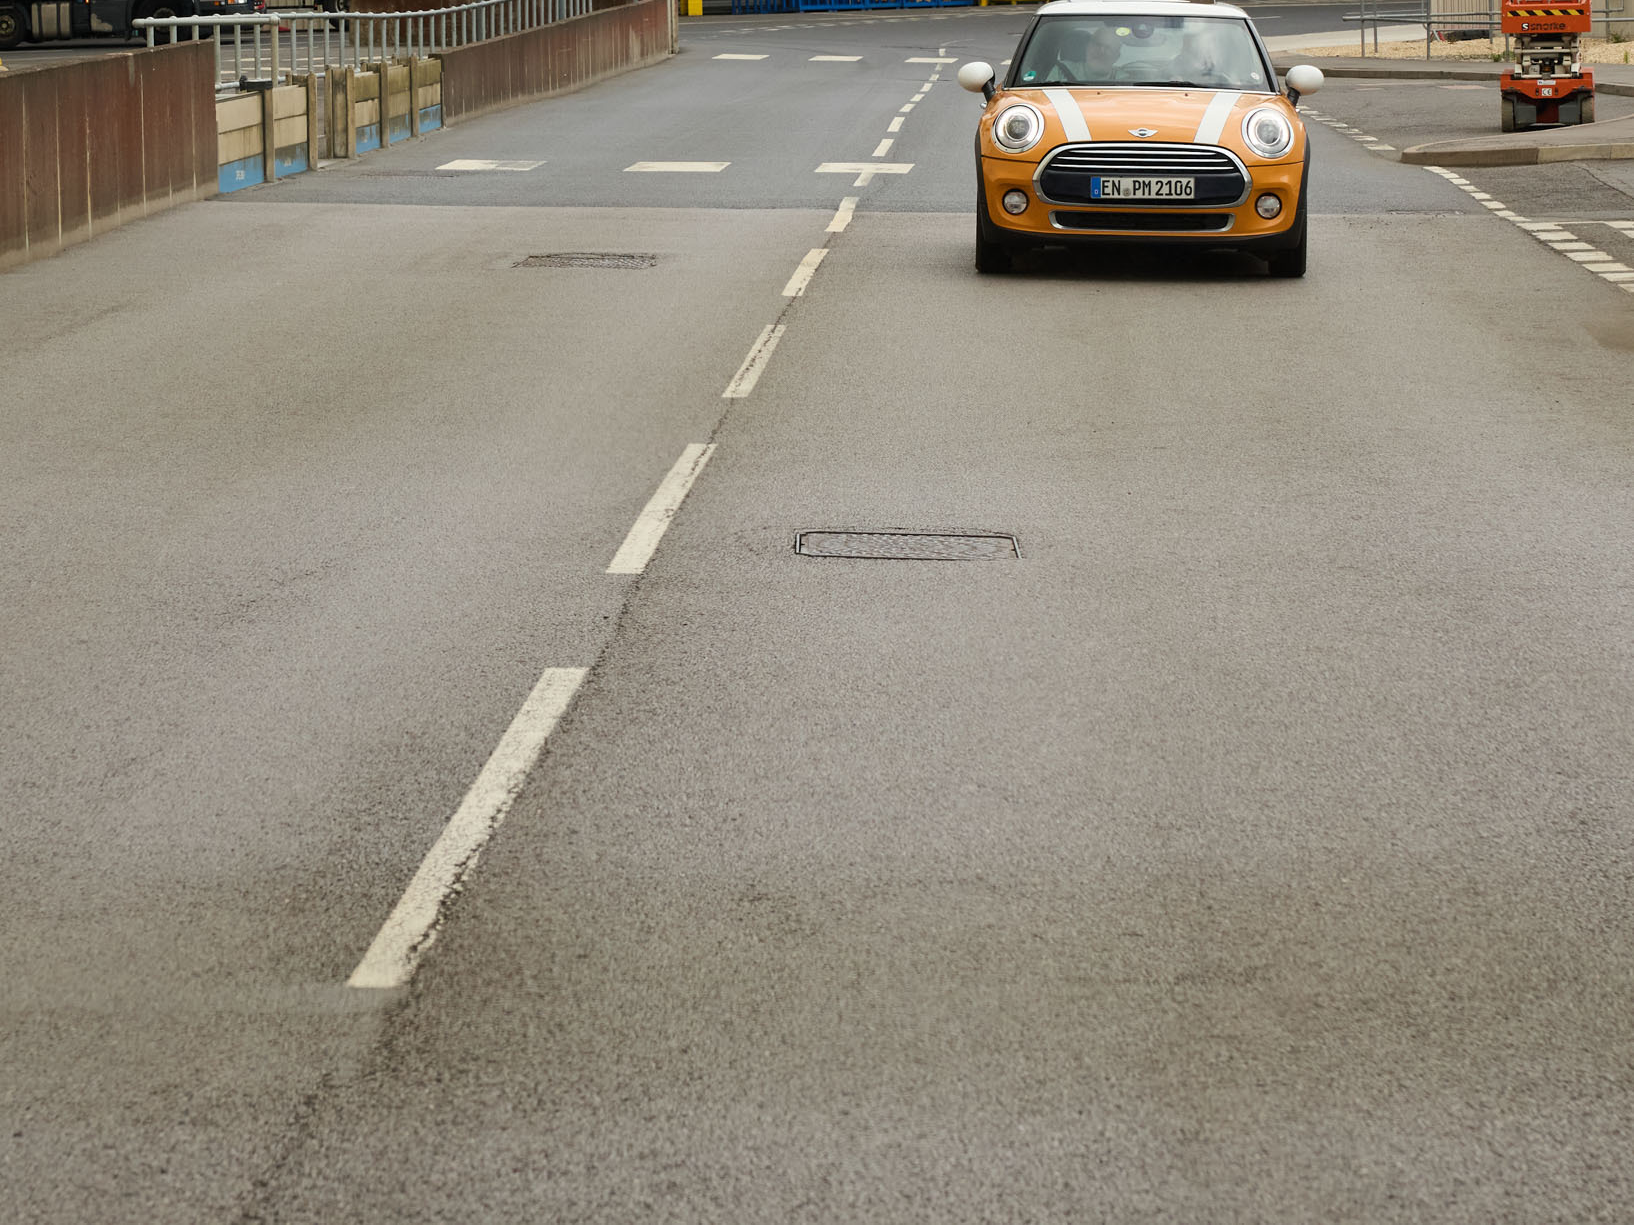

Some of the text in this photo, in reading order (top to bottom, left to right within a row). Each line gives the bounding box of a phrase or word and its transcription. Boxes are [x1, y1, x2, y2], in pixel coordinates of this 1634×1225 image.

[1101, 180, 1193, 196] EN PM 2106
